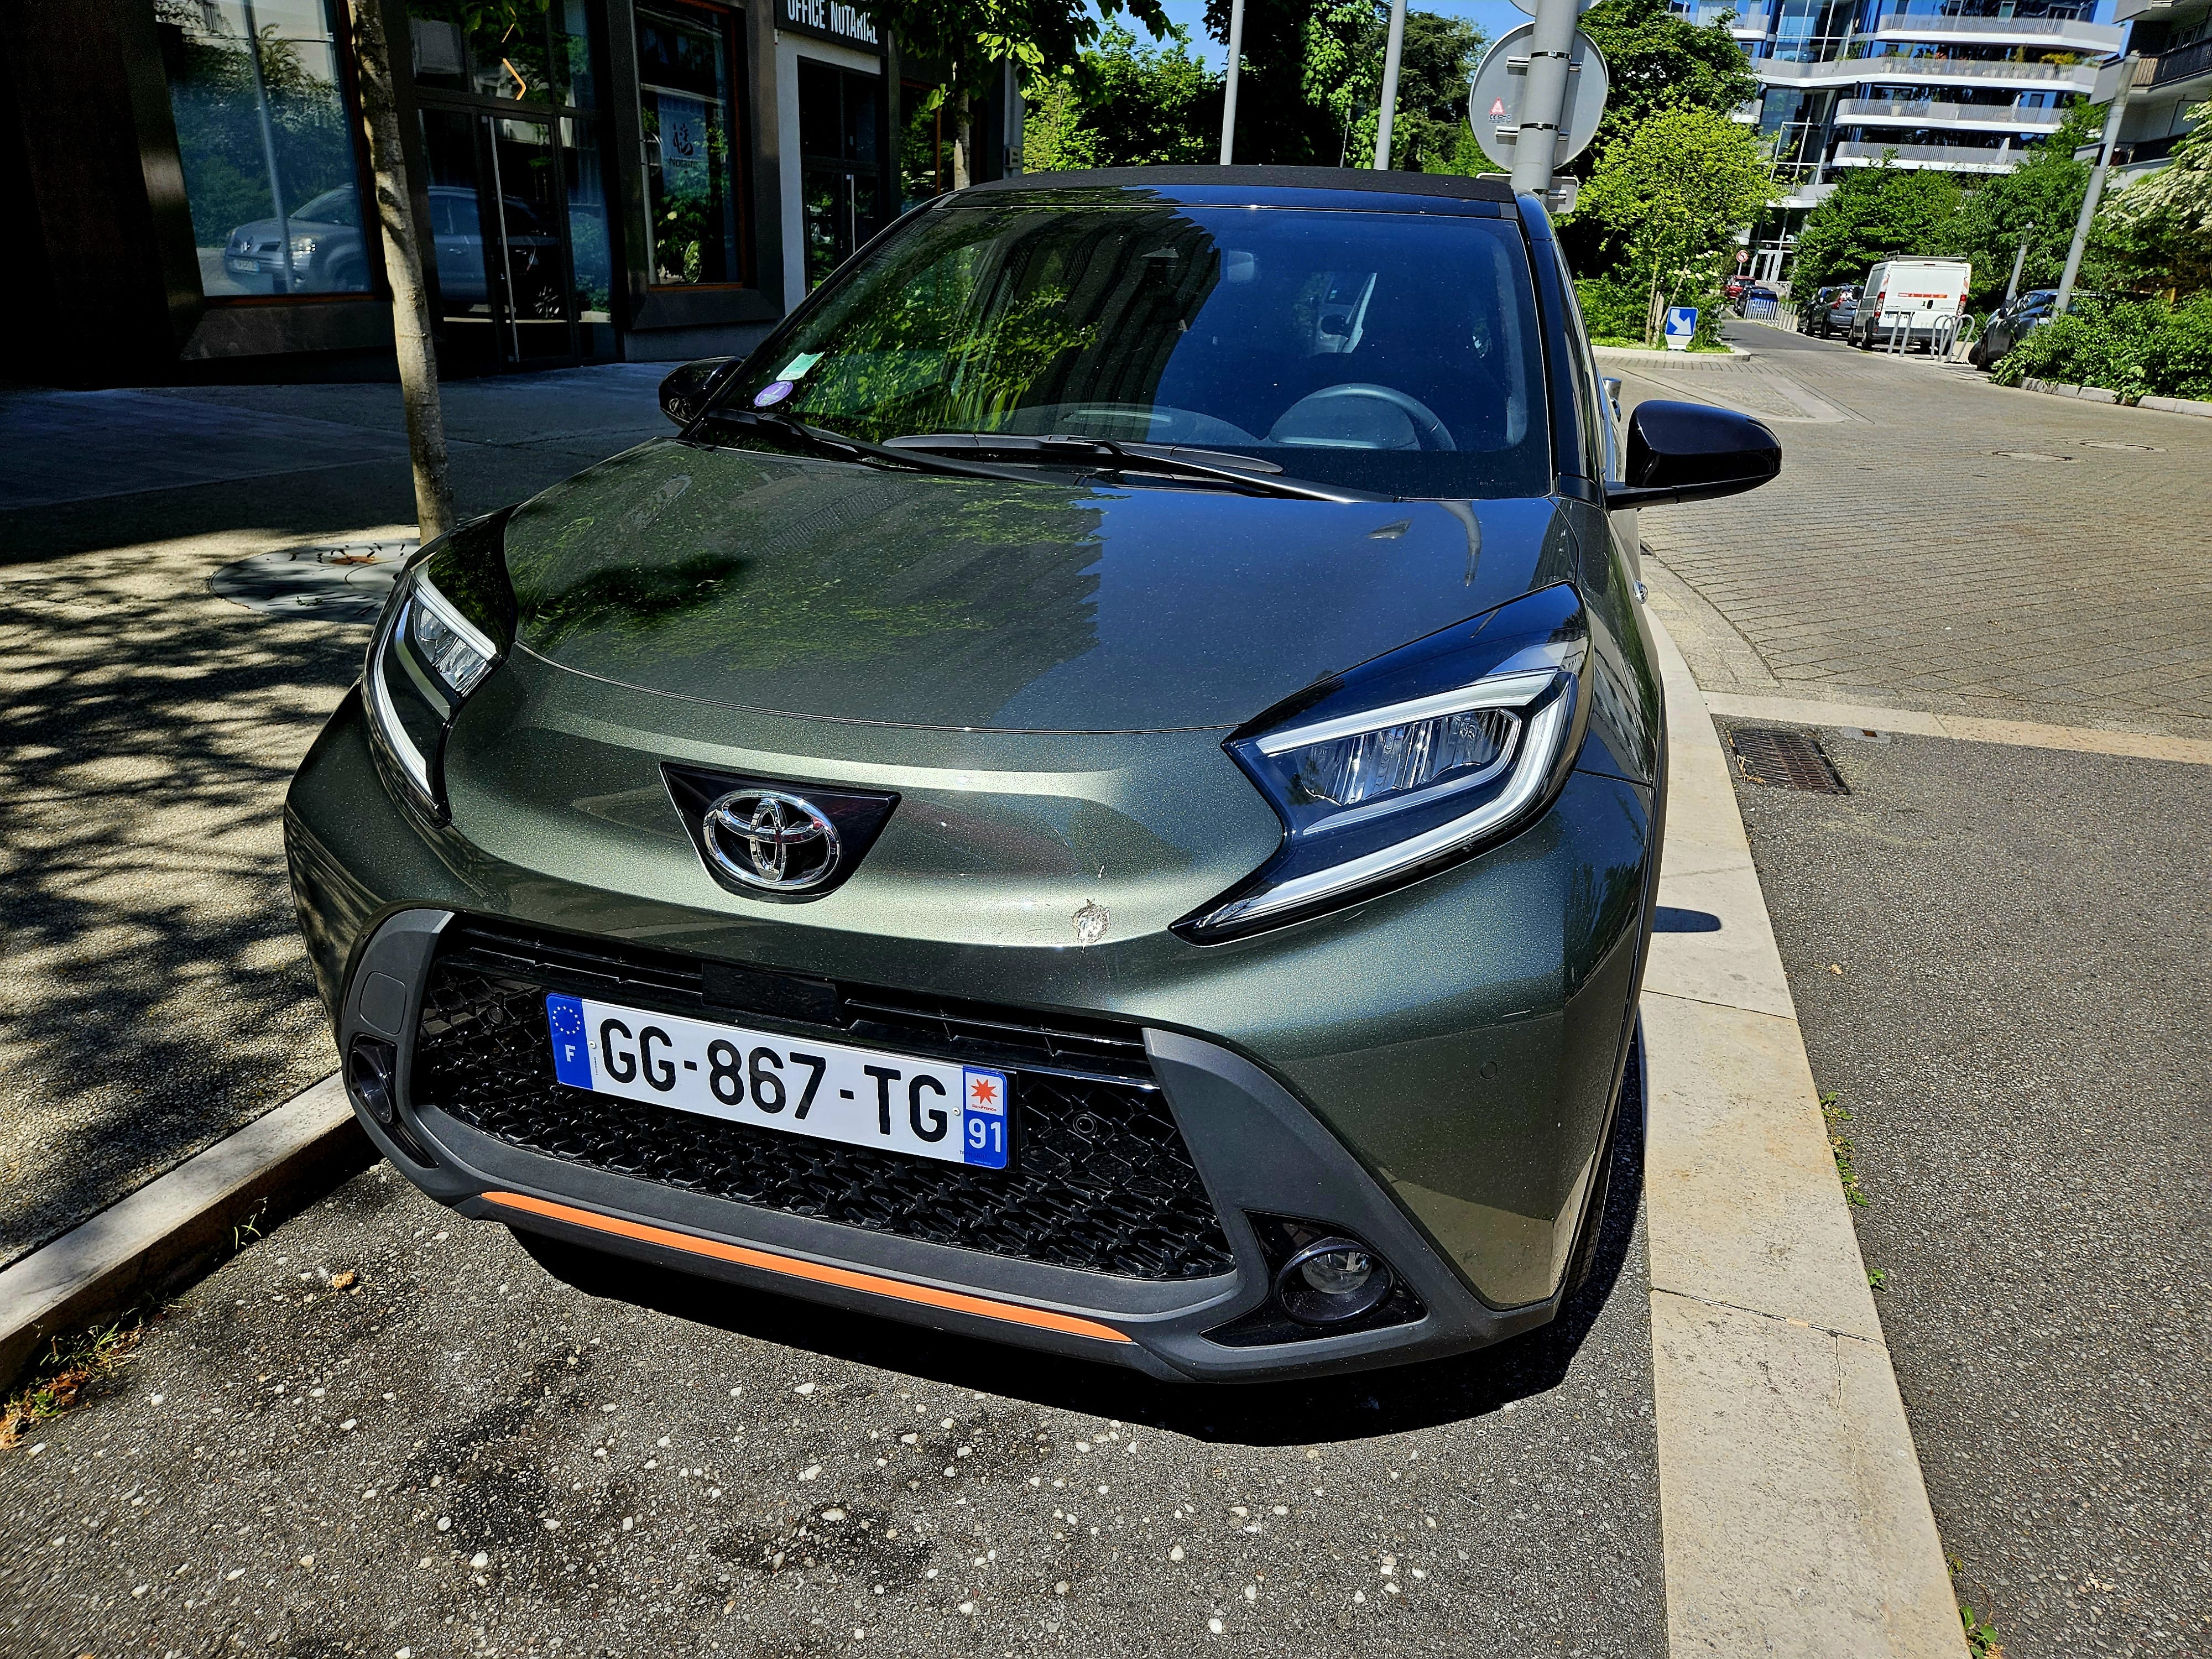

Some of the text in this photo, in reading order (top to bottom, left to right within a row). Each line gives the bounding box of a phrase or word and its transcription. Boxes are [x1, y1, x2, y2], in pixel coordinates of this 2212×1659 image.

[787, 0, 878, 44] OFFICE NOTARIAL
[565, 1044, 576, 1062] F
[600, 1018, 948, 1142] GG-867-TG
[969, 1118, 1001, 1152] 91
